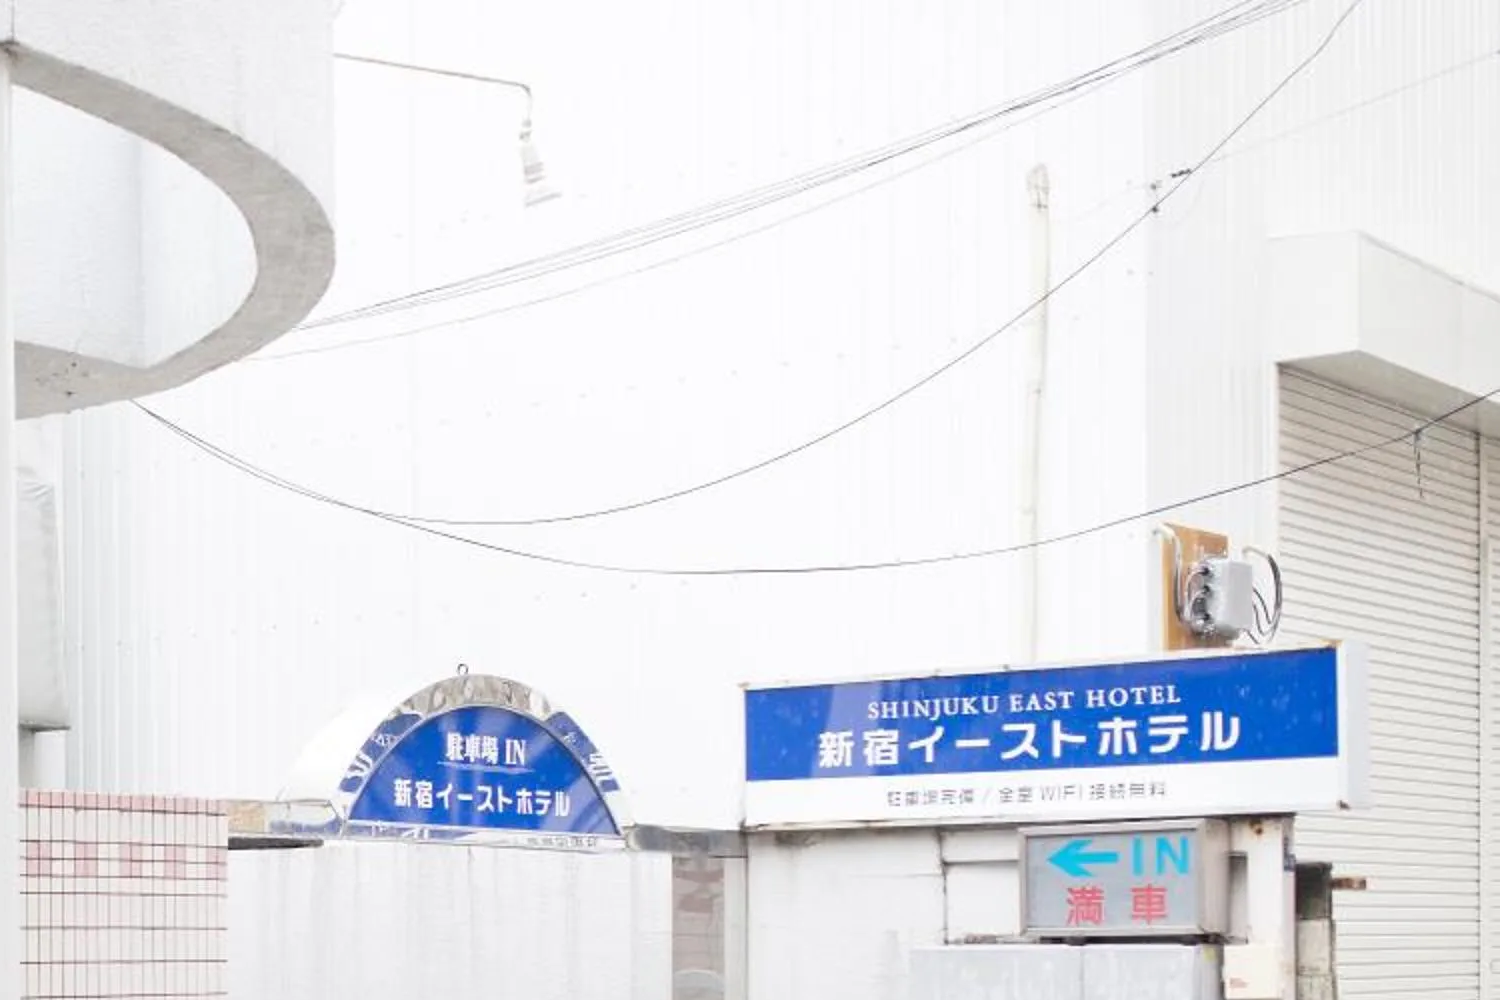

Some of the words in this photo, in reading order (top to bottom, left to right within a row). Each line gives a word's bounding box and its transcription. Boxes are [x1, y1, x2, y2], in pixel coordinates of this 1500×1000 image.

[867, 695, 999, 721] SHINJUKU
[1009, 691, 1075, 713] EAST
[1086, 685, 1181, 708] HOTEL
[446, 731, 498, 765] 駐車場
[505, 739, 526, 766] IN
[817, 711, 1241, 768] 新宿イーストホテル
[393, 778, 571, 817] 新宿イーストホテル
[1041, 785, 1083, 801] WIFI
[1132, 835, 1190, 876] IN
[1066, 884, 1169, 926] 満車
